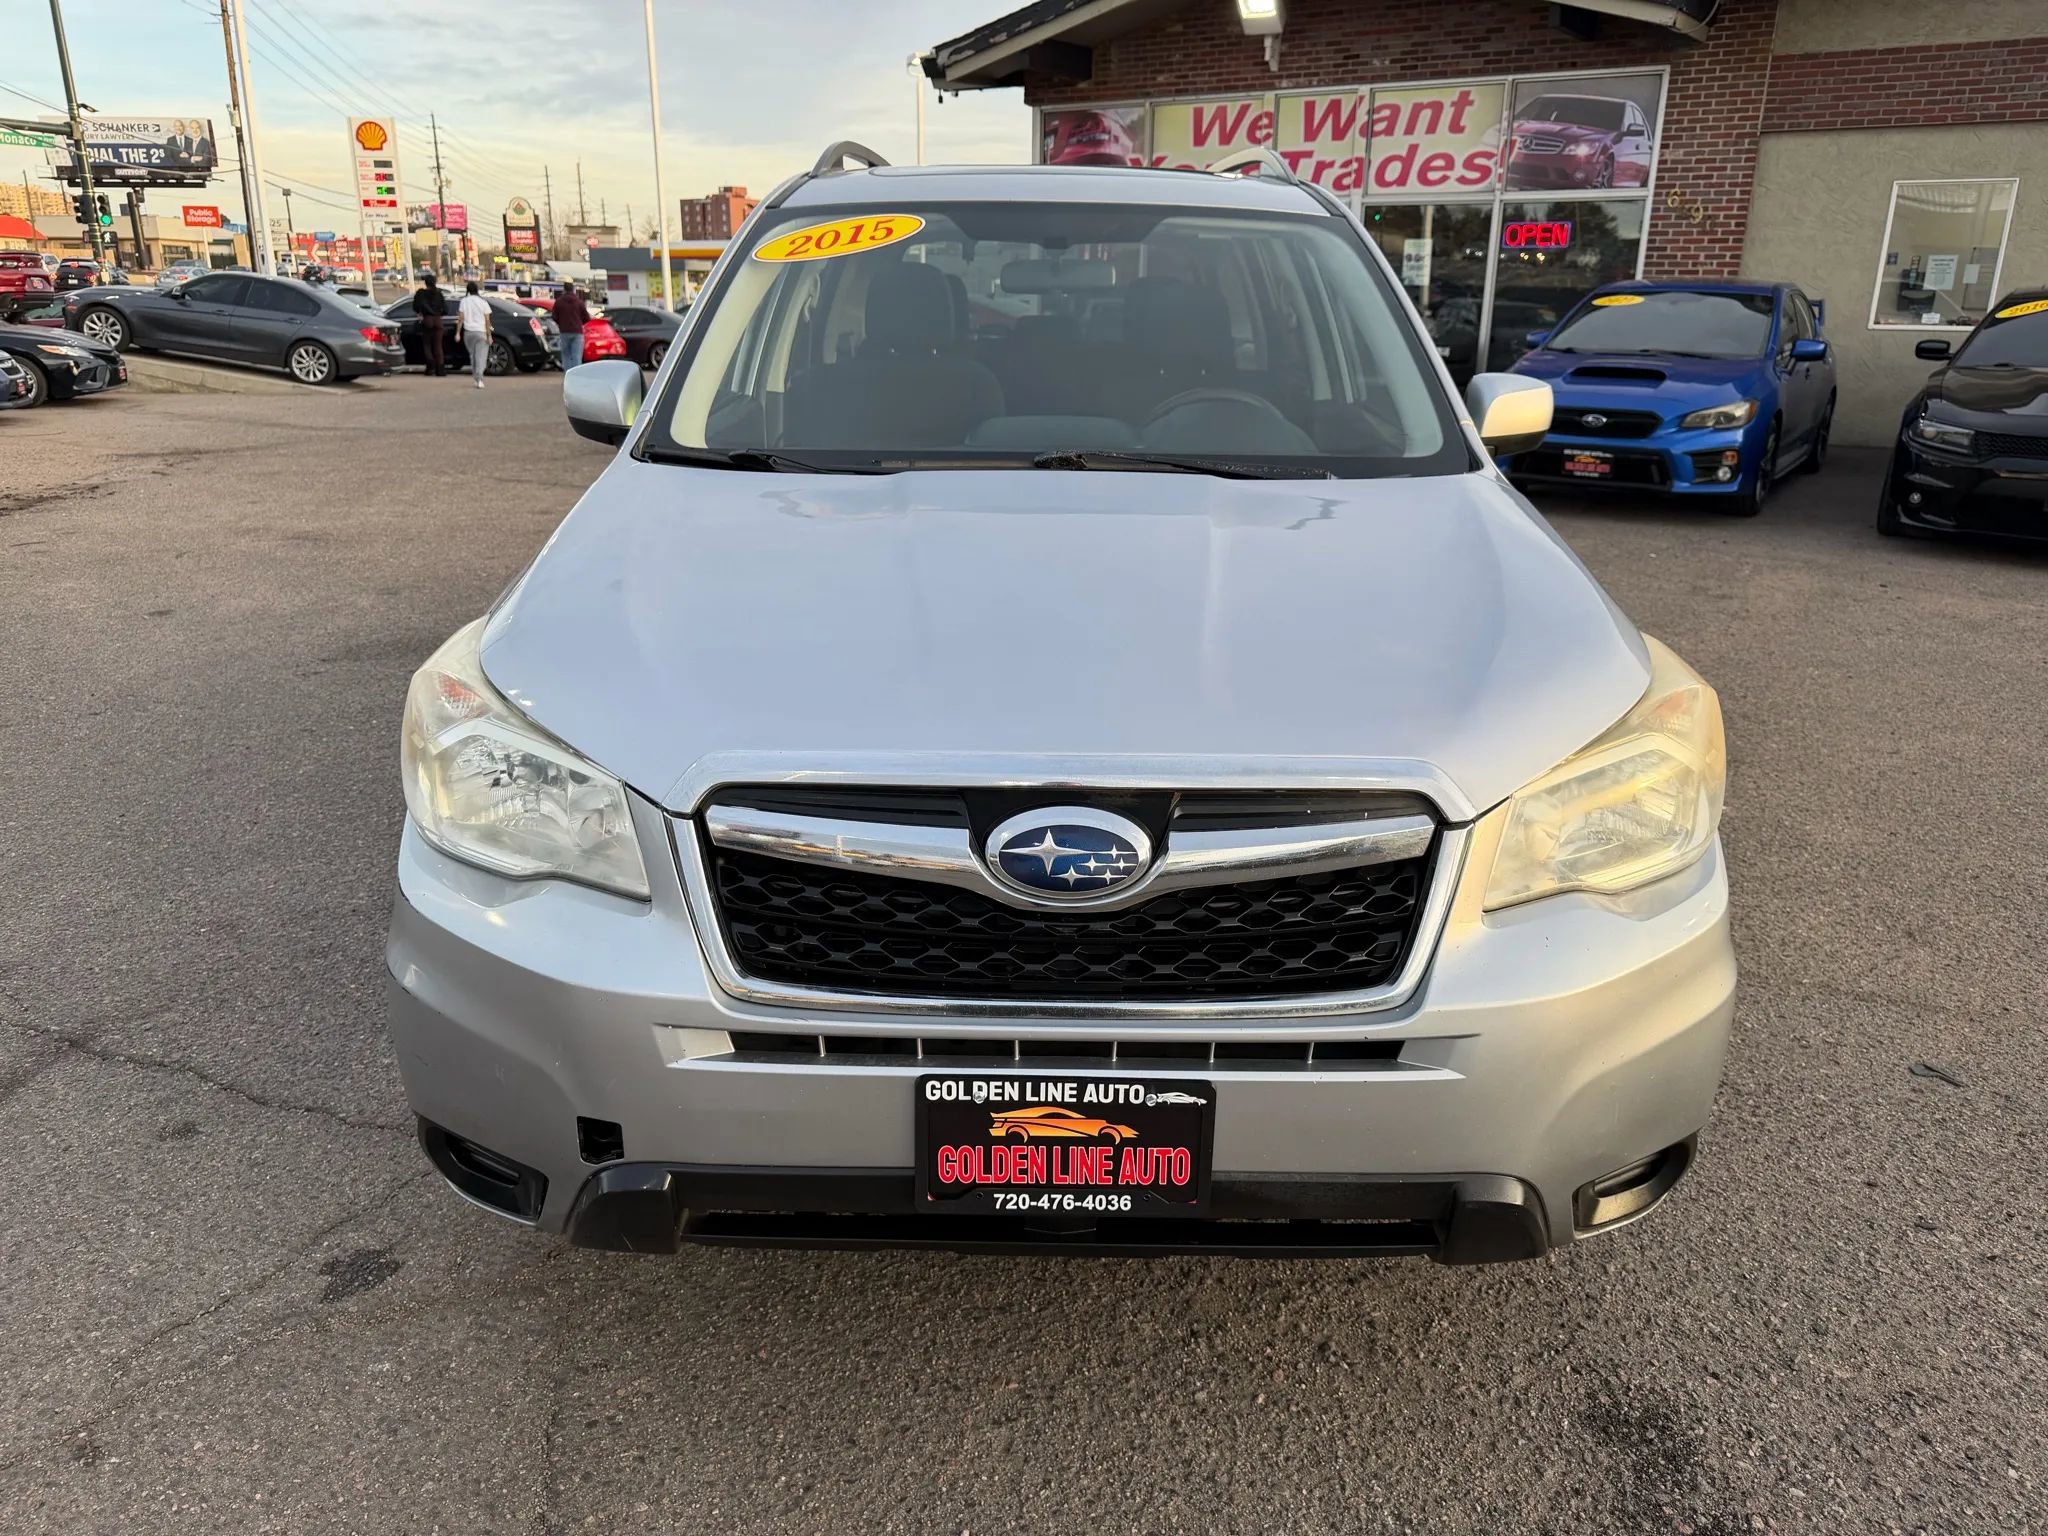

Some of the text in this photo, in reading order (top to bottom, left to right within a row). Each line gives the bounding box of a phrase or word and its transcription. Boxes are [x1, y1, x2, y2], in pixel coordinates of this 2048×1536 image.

[92, 123, 149, 133] SCHANKER
[1192, 90, 1474, 147] We Want
[119, 149, 148, 164] THE
[187, 216, 217, 224] Storage
[189, 208, 213, 217] Public
[784, 218, 896, 257] 2015
[1504, 223, 1569, 247] OPEN
[925, 1080, 1145, 1105] GOLDEN LINE AUTO
[937, 1145, 1191, 1186] GOLDEN LINE AUTO
[993, 1193, 1132, 1211] 720-476-4036
